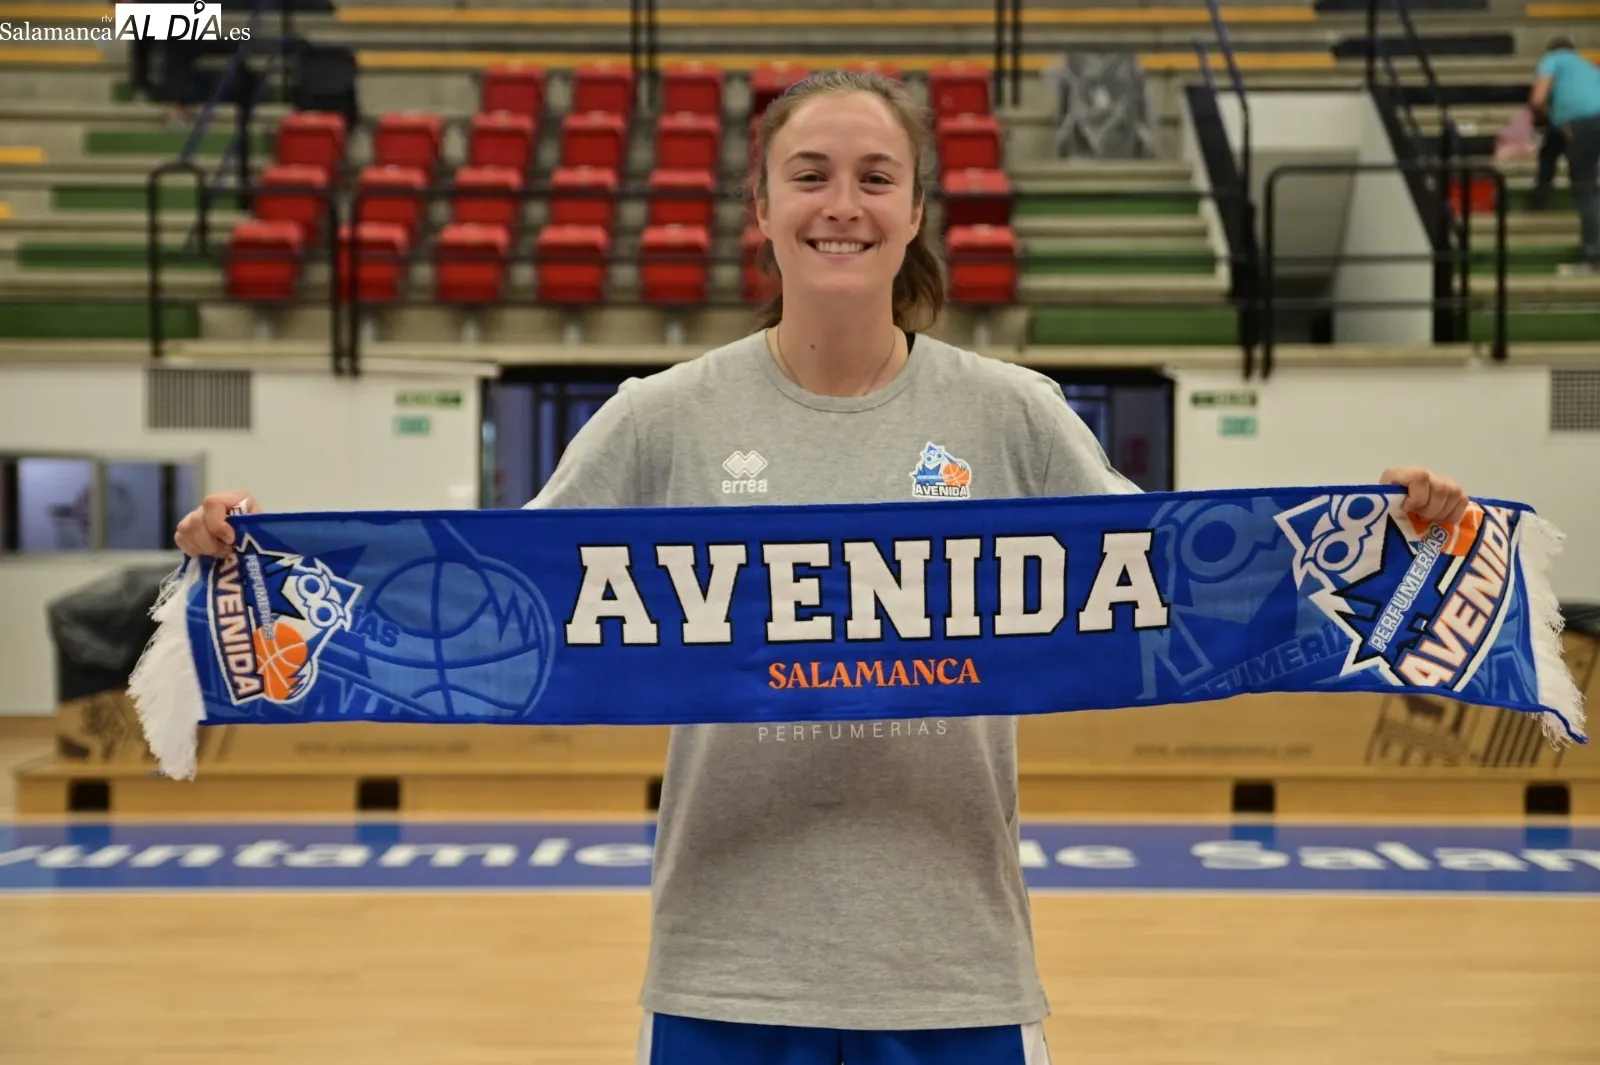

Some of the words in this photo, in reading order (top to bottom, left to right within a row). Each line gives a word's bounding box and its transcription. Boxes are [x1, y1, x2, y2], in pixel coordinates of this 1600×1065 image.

[915, 483, 968, 498] AVENIDA
[565, 530, 1169, 646] AVENIDA
[767, 656, 982, 691] SALAMANCA
[757, 718, 948, 743] PERFUMERÍAS
